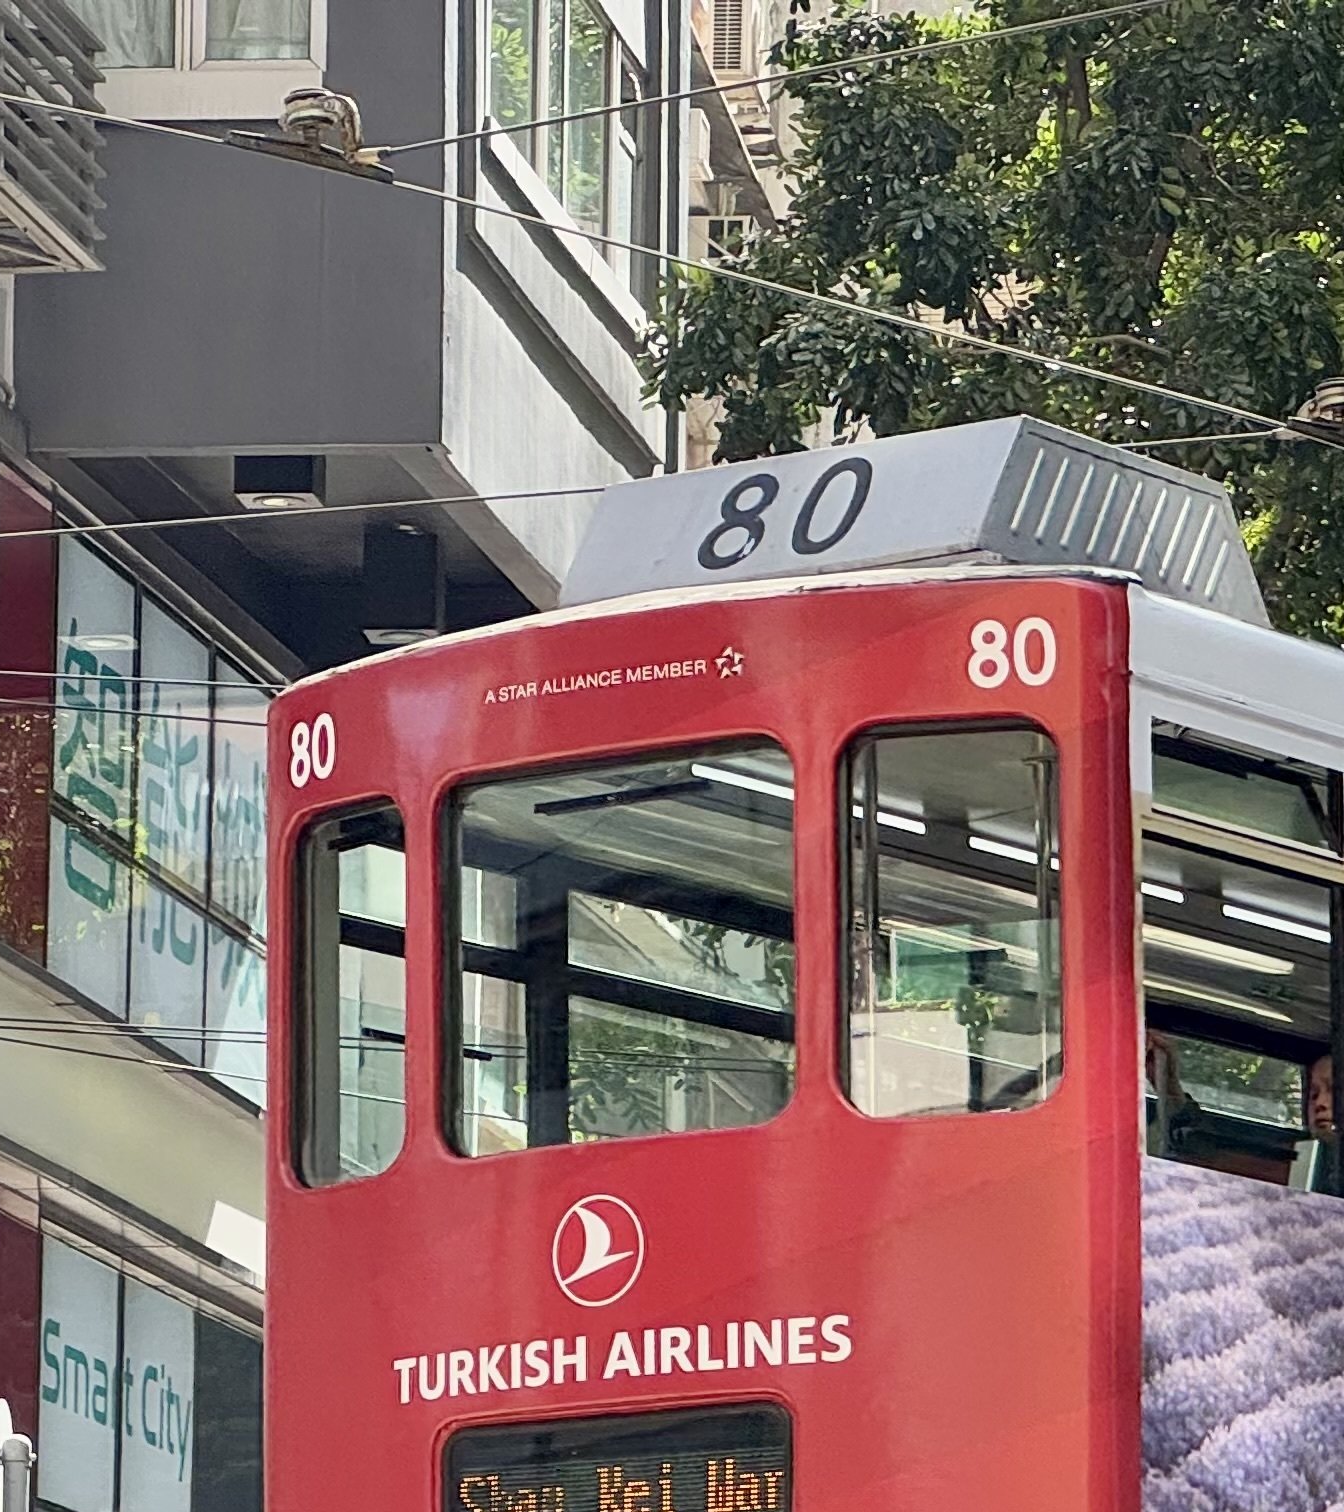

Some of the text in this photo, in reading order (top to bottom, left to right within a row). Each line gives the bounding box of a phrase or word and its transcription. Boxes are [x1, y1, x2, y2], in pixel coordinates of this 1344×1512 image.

[697, 458, 873, 570] 80
[485, 659, 707, 705] A STAR ALLIANCE MEMBER
[967, 616, 1057, 688] 80
[289, 712, 336, 788] 80
[42, 1317, 134, 1438] Smart
[141, 1363, 193, 1482] City
[393, 1314, 853, 1404] TURKISH AIRLINES
